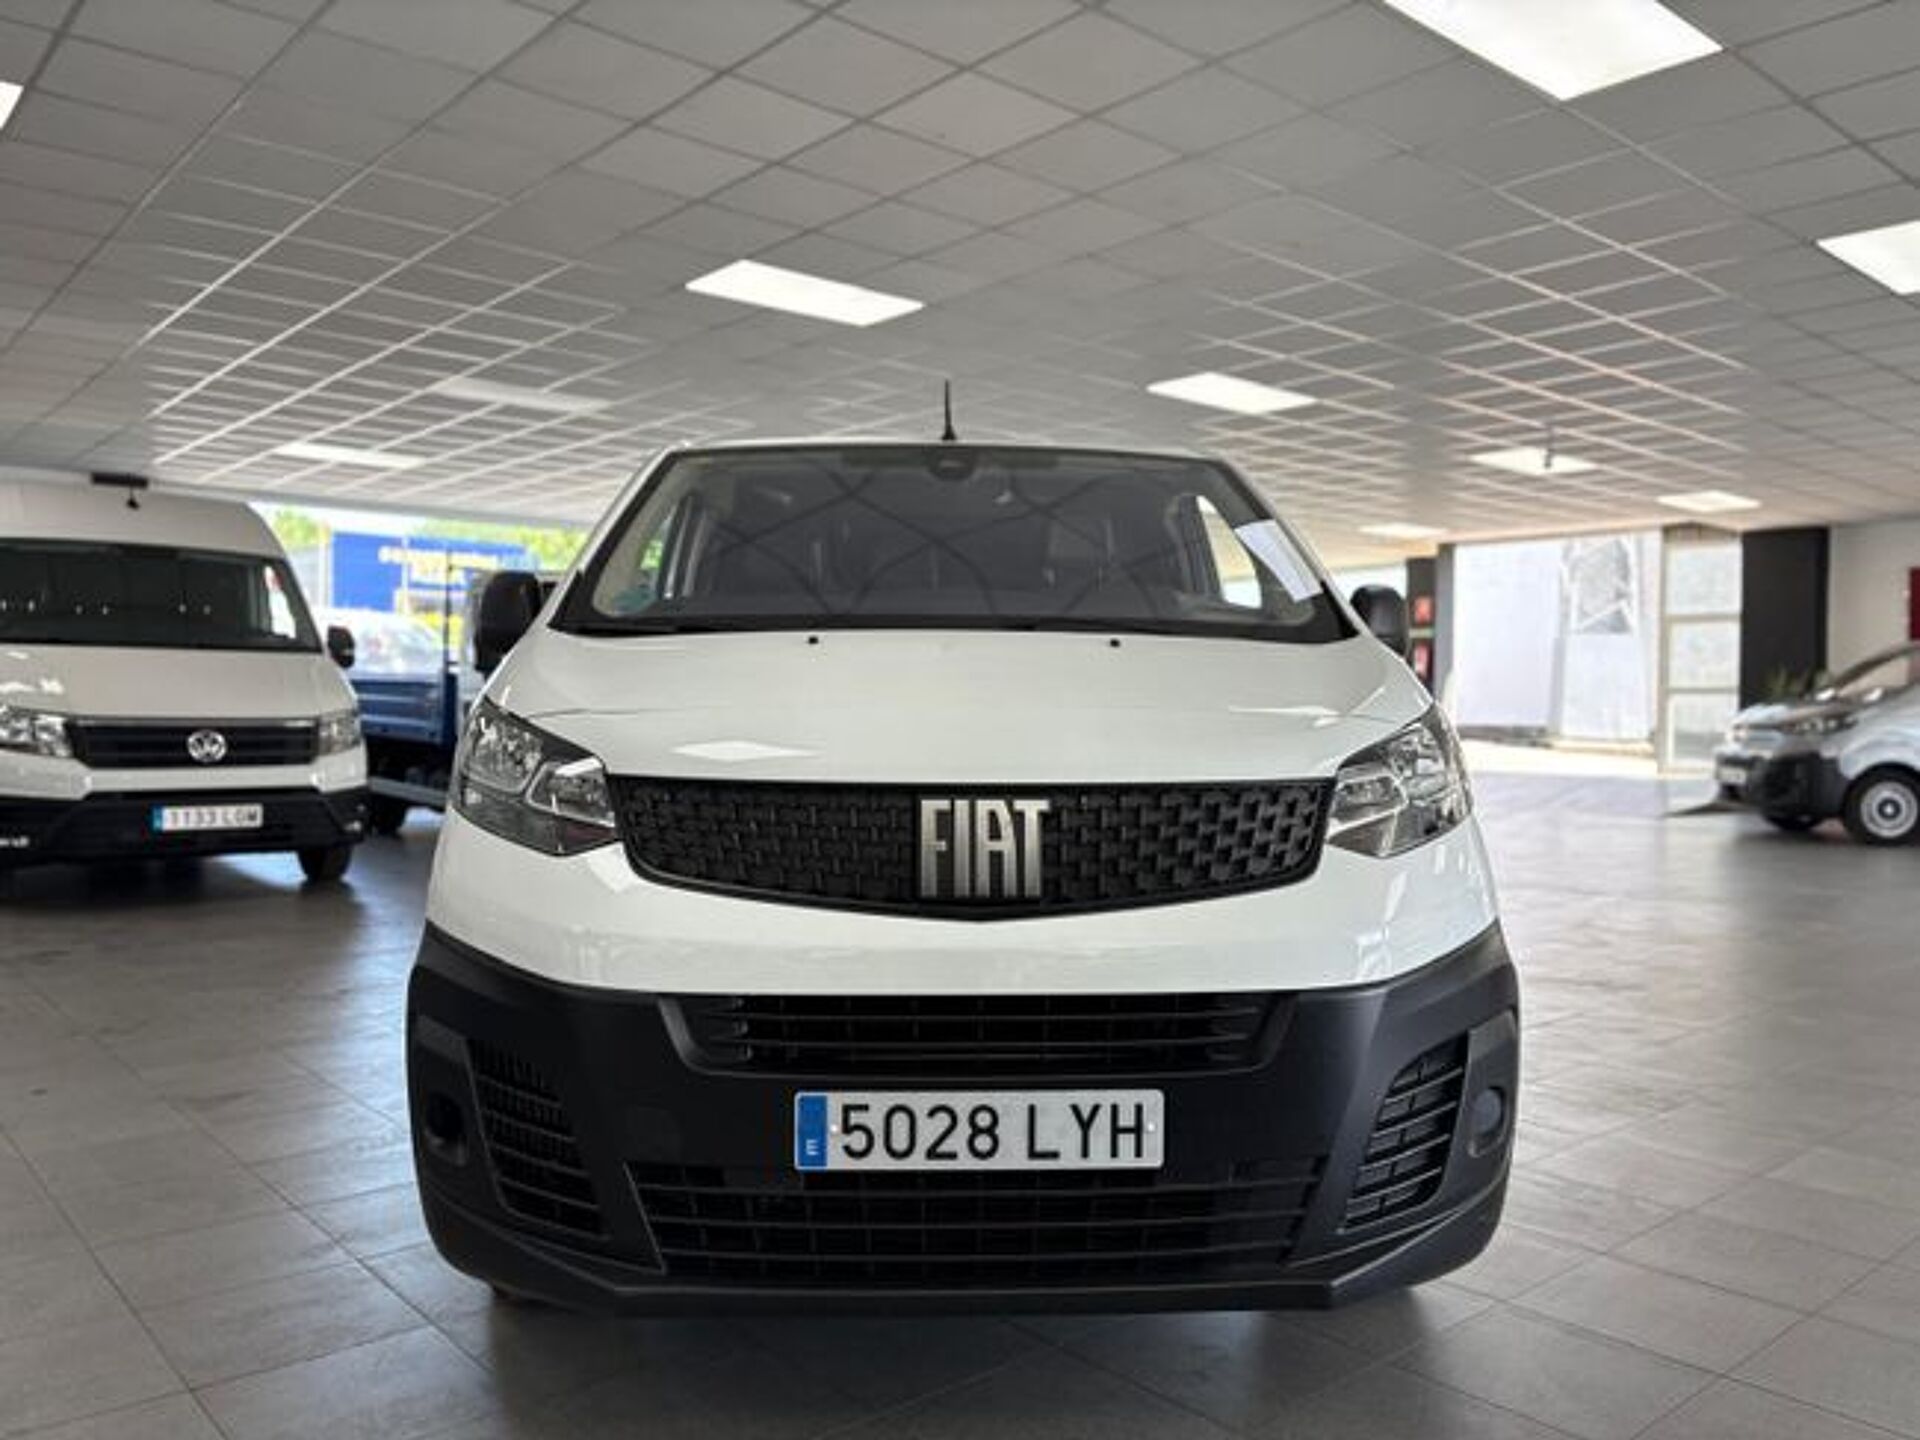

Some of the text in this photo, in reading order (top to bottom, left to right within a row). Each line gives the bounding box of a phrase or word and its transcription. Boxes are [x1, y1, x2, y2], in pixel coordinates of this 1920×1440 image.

[920, 799, 1050, 898] FIAT
[841, 1103, 1000, 1161] 5028
[1026, 1102, 1145, 1160] LYH
